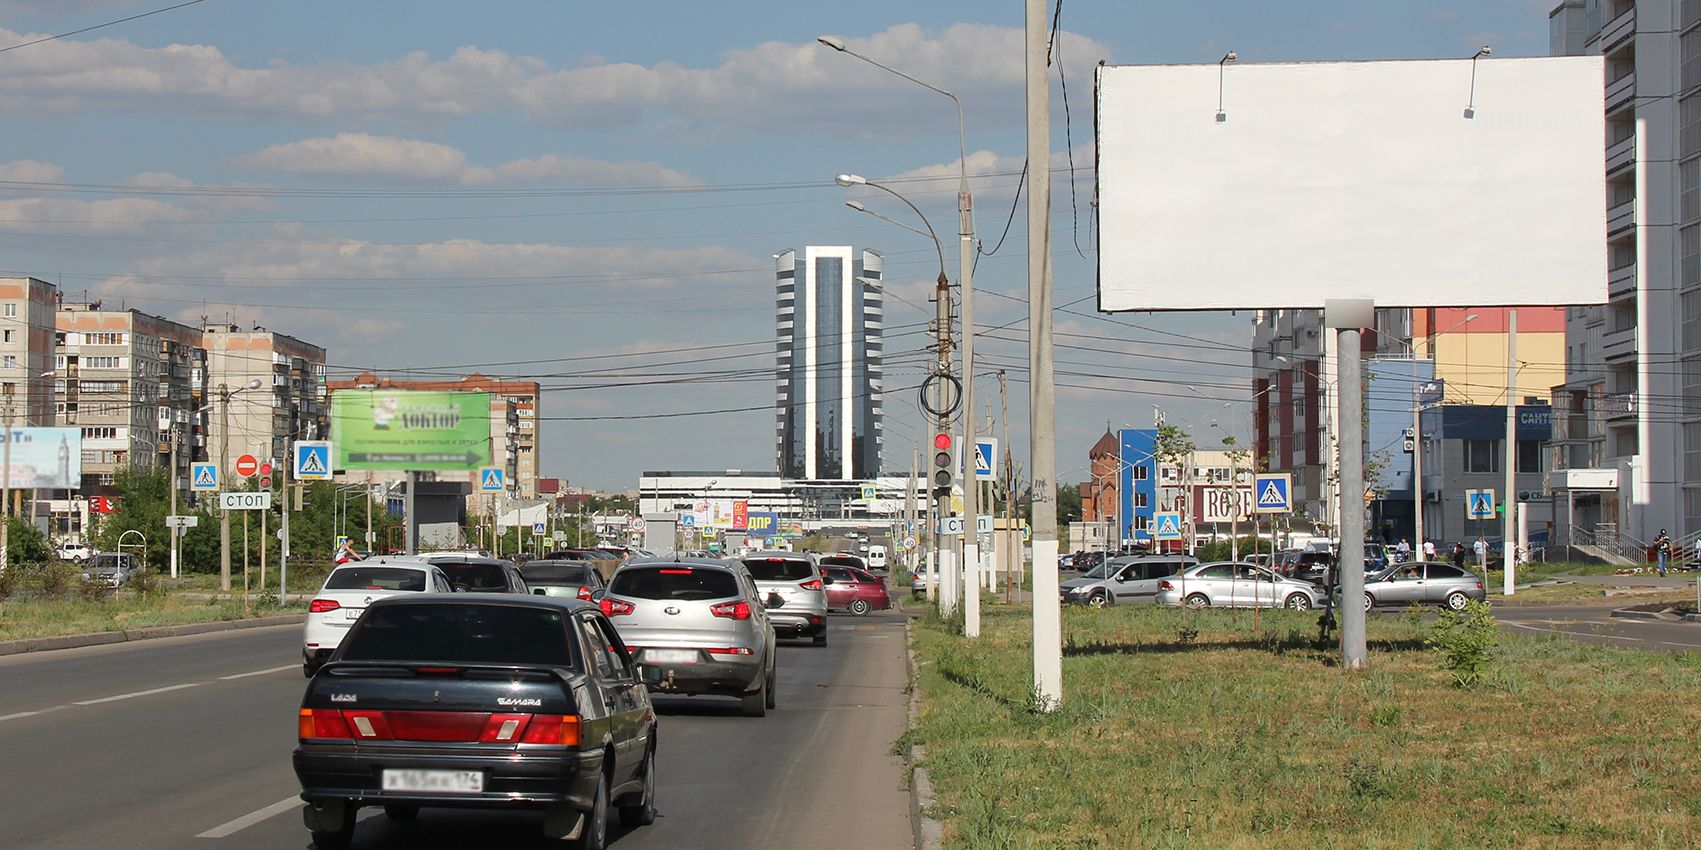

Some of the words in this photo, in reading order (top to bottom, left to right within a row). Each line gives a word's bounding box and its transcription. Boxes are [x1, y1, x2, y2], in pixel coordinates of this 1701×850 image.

[227, 495, 262, 506] СТОП
[748, 517, 772, 530] ДПР
[949, 519, 986, 531] СТП
[331, 694, 357, 702] LADA
[497, 697, 541, 706] SAMARA
